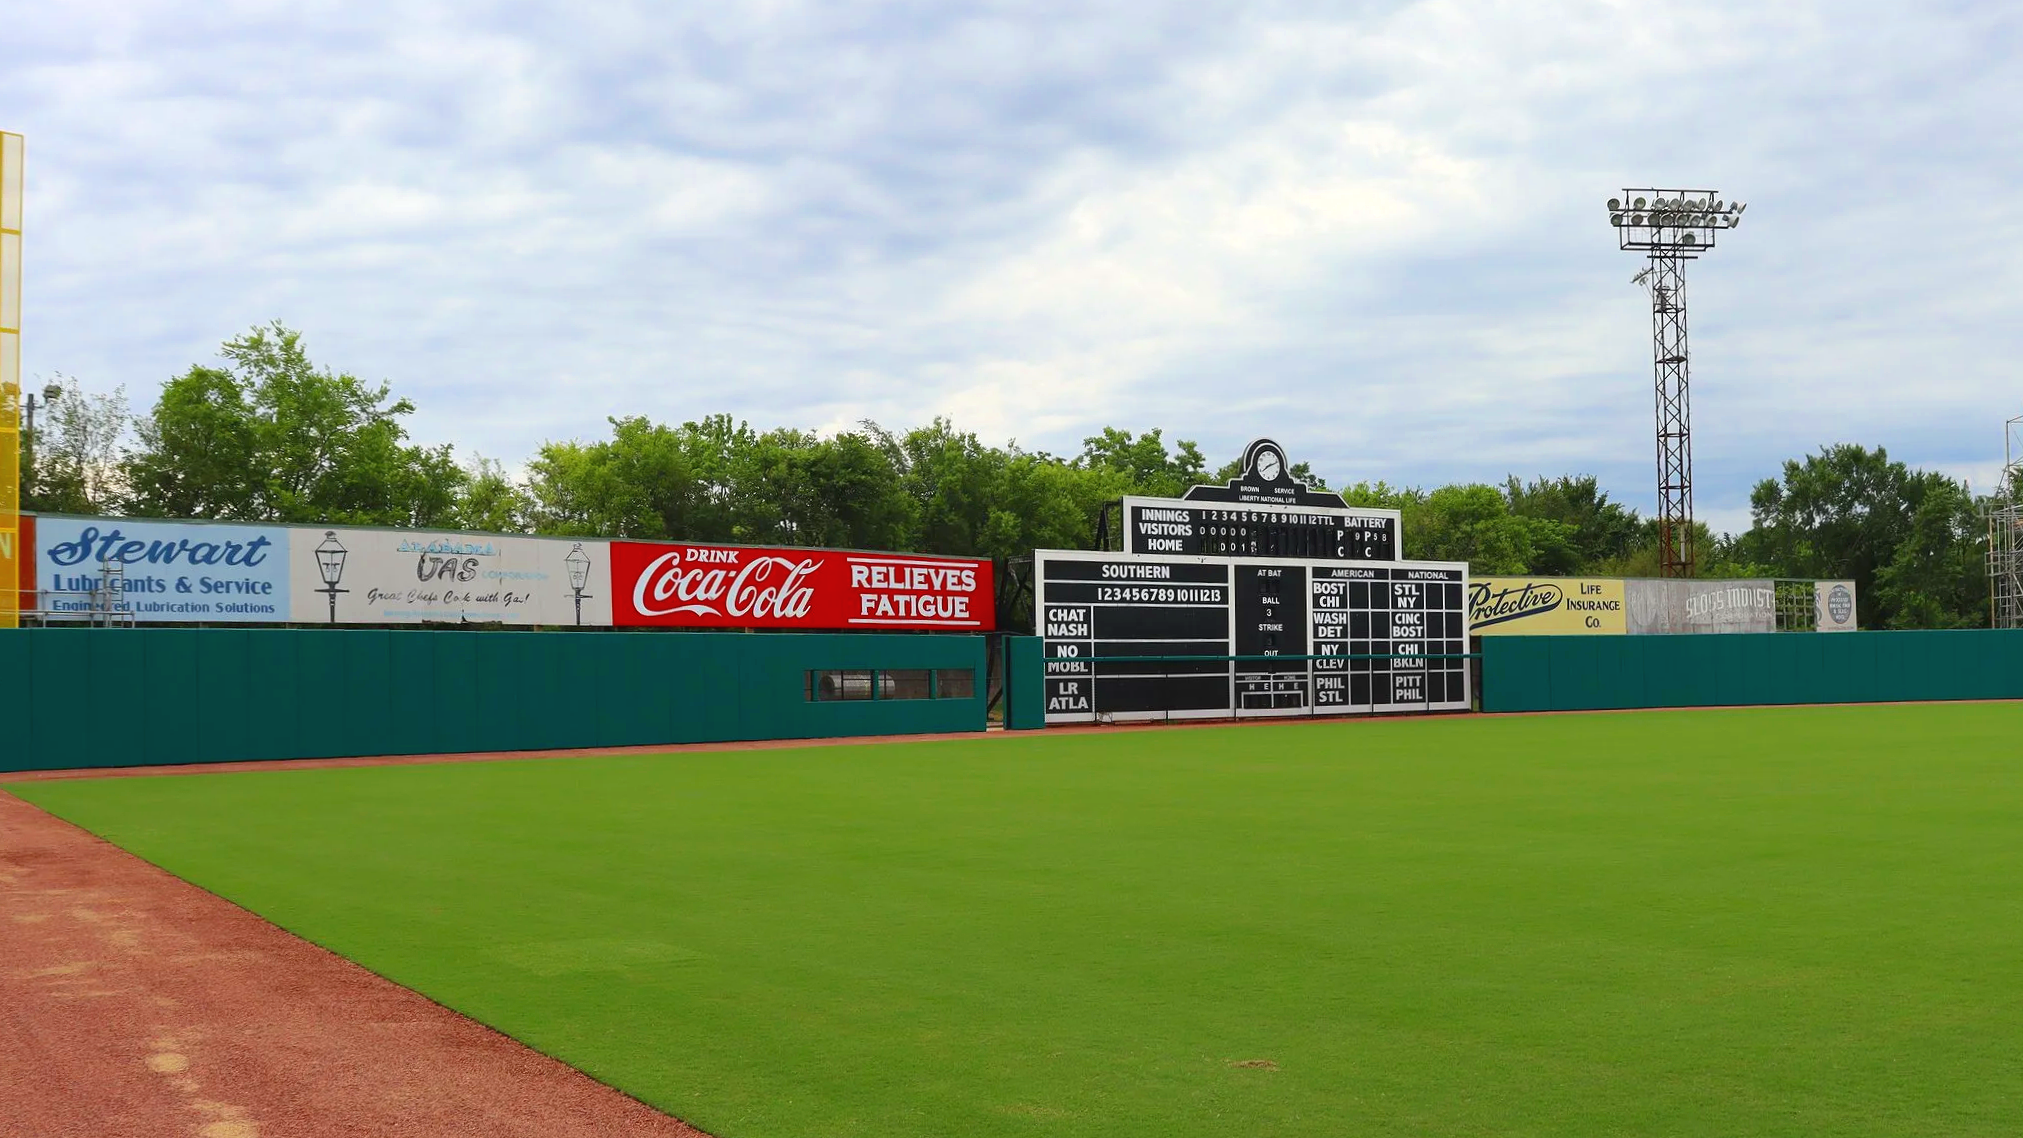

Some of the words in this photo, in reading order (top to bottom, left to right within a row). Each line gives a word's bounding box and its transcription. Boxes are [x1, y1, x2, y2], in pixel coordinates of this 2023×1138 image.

[1240, 485, 1260, 493] BROWN
[1274, 487, 1295, 495] SERVICE
[1142, 509, 1190, 522] INNINGS
[1202, 511, 1206, 520] 1
[1212, 511, 1217, 520] 2
[1222, 511, 1228, 521] 3
[1230, 512, 1237, 521] 4
[1241, 512, 1247, 521] 5
[1251, 513, 1257, 522] 6
[1261, 513, 1268, 522] 7
[1271, 514, 1277, 523] 8
[1281, 514, 1287, 523] 9
[1289, 514, 1298, 524] 10
[1300, 515, 1306, 524] 11
[1309, 515, 1317, 525] 12
[1317, 516, 1334, 525] TTL
[1344, 516, 1387, 528] BATTERY
[1139, 523, 1193, 536] VISITORS
[1337, 530, 1344, 541] P
[1365, 531, 1371, 541] P
[47, 526, 271, 567] Stewart
[1148, 539, 1183, 551] HOME
[1337, 546, 1344, 557] C
[1365, 547, 1372, 557] C
[685, 548, 739, 564] DRINK
[1101, 564, 1170, 578] SOUTHERN
[1257, 569, 1267, 577] AT
[1268, 569, 1282, 577] BAT
[1331, 569, 1375, 578] AMERICAN
[1408, 571, 1449, 580] NATIONAL
[850, 564, 976, 592] RELIEVES
[53, 574, 166, 593] Lubrcants
[175, 576, 193, 594] &
[199, 577, 273, 595] Service
[633, 552, 824, 619] Coca-Cola
[1313, 582, 1345, 595] BOST
[1394, 584, 1420, 596] STL
[1580, 582, 1602, 595] LIFE
[443, 590, 471, 604] Cok
[475, 592, 499, 603] with
[1319, 596, 1340, 608] CHI
[1397, 597, 1417, 608] NY
[1469, 583, 1557, 621] Protective
[53, 600, 130, 612] Engineed
[136, 601, 210, 613] Lubrication
[216, 602, 275, 614] Solutions
[860, 593, 970, 618] FATIGUE
[1566, 598, 1620, 611] INSURANCE
[1049, 609, 1086, 622] CHAT
[1266, 608, 1272, 617] 3
[1313, 612, 1347, 625] WASH
[1395, 613, 1420, 625] CINC
[1047, 623, 1088, 636] NASH
[1318, 626, 1343, 638] DET
[1393, 626, 1423, 638] BOST
[1057, 645, 1078, 658] NO
[1321, 644, 1339, 656] NY
[1398, 644, 1418, 655] CHI
[1047, 661, 1088, 672] MOBL
[1315, 658, 1345, 669] CLEV
[1393, 658, 1424, 668] BKLN
[1316, 677, 1345, 689] PHIL
[1395, 676, 1422, 687] PITT
[1059, 682, 1079, 694] LR
[1395, 688, 1423, 700] PHIL
[1318, 691, 1343, 703] STL
[1049, 697, 1088, 710] ATLA
